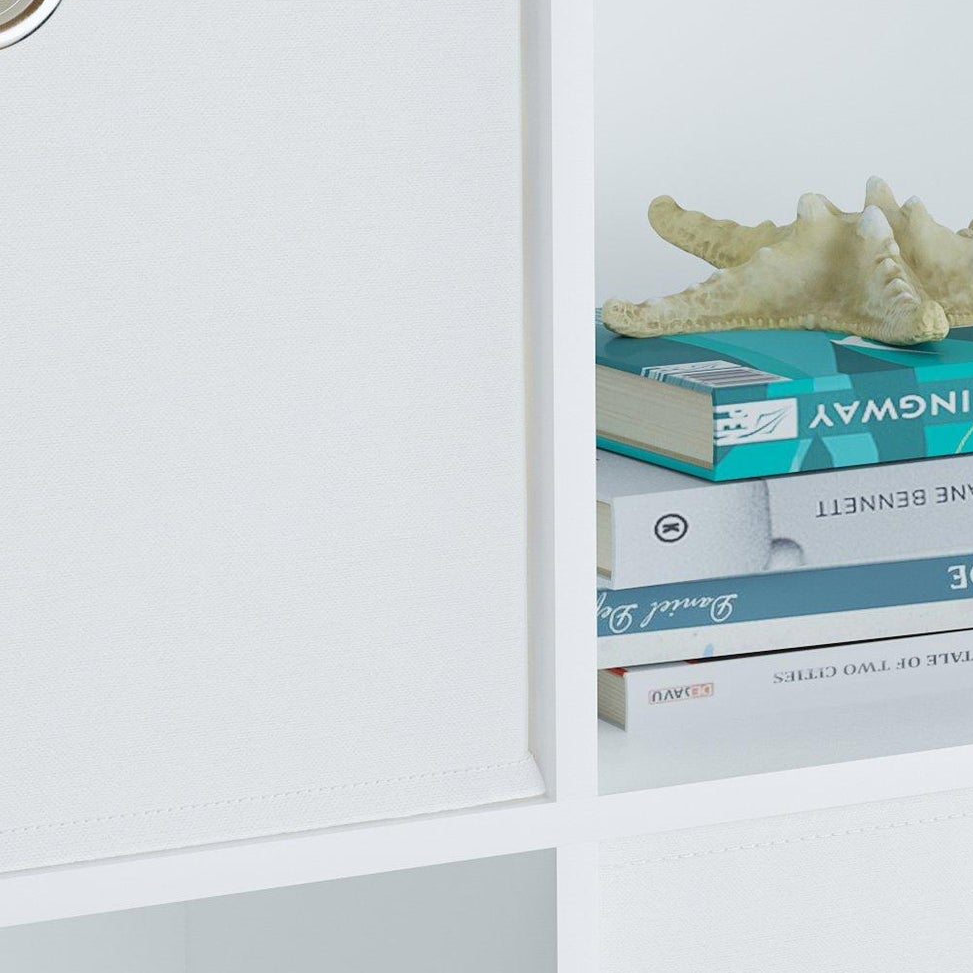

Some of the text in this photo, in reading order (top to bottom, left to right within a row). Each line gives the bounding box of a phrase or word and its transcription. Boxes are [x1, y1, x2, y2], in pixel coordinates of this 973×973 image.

[815, 489, 927, 518] BENNETT
[640, 593, 738, 628] Daniel
[843, 659, 891, 677] TWO
[896, 655, 921, 670] OF
[772, 665, 838, 684] CITIES
